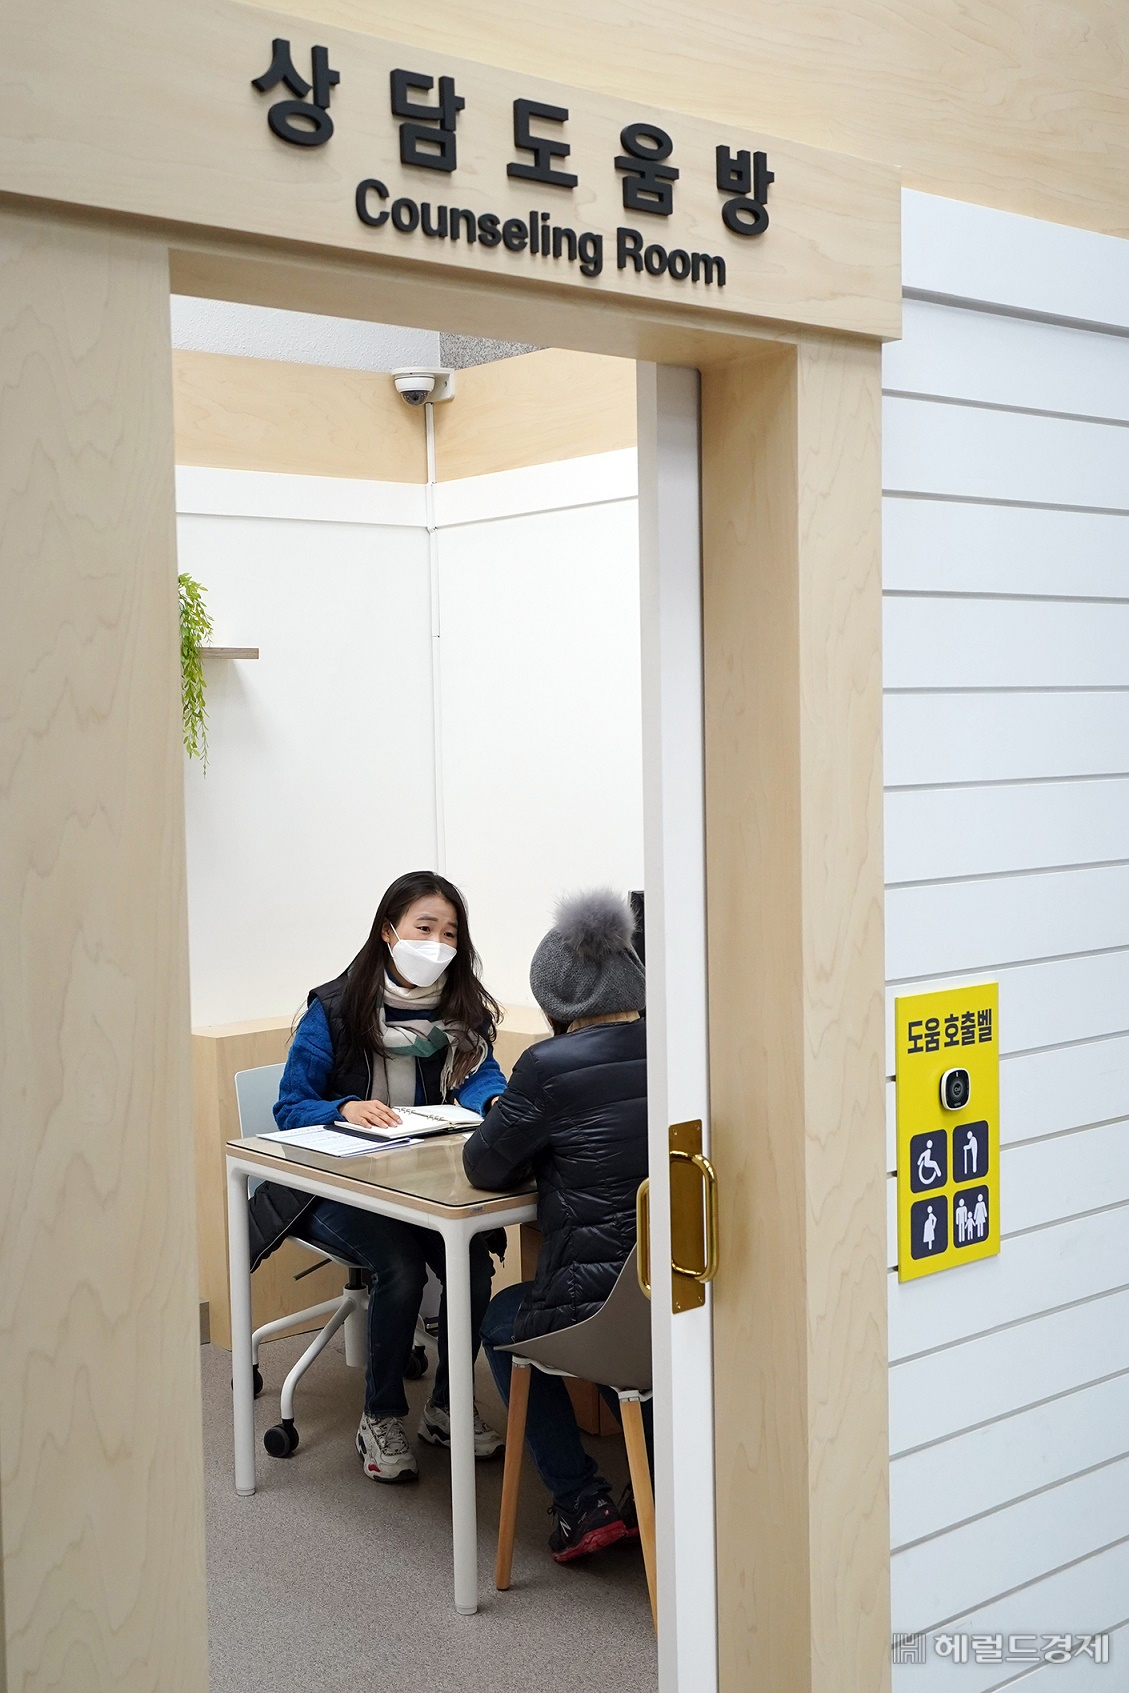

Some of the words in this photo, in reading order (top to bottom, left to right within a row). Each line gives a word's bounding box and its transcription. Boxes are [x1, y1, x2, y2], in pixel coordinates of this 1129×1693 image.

[355, 178, 603, 277] Counseling
[616, 226, 726, 287] Room
[907, 1017, 941, 1054] 도움
[944, 1008, 992, 1047] 호출벨
